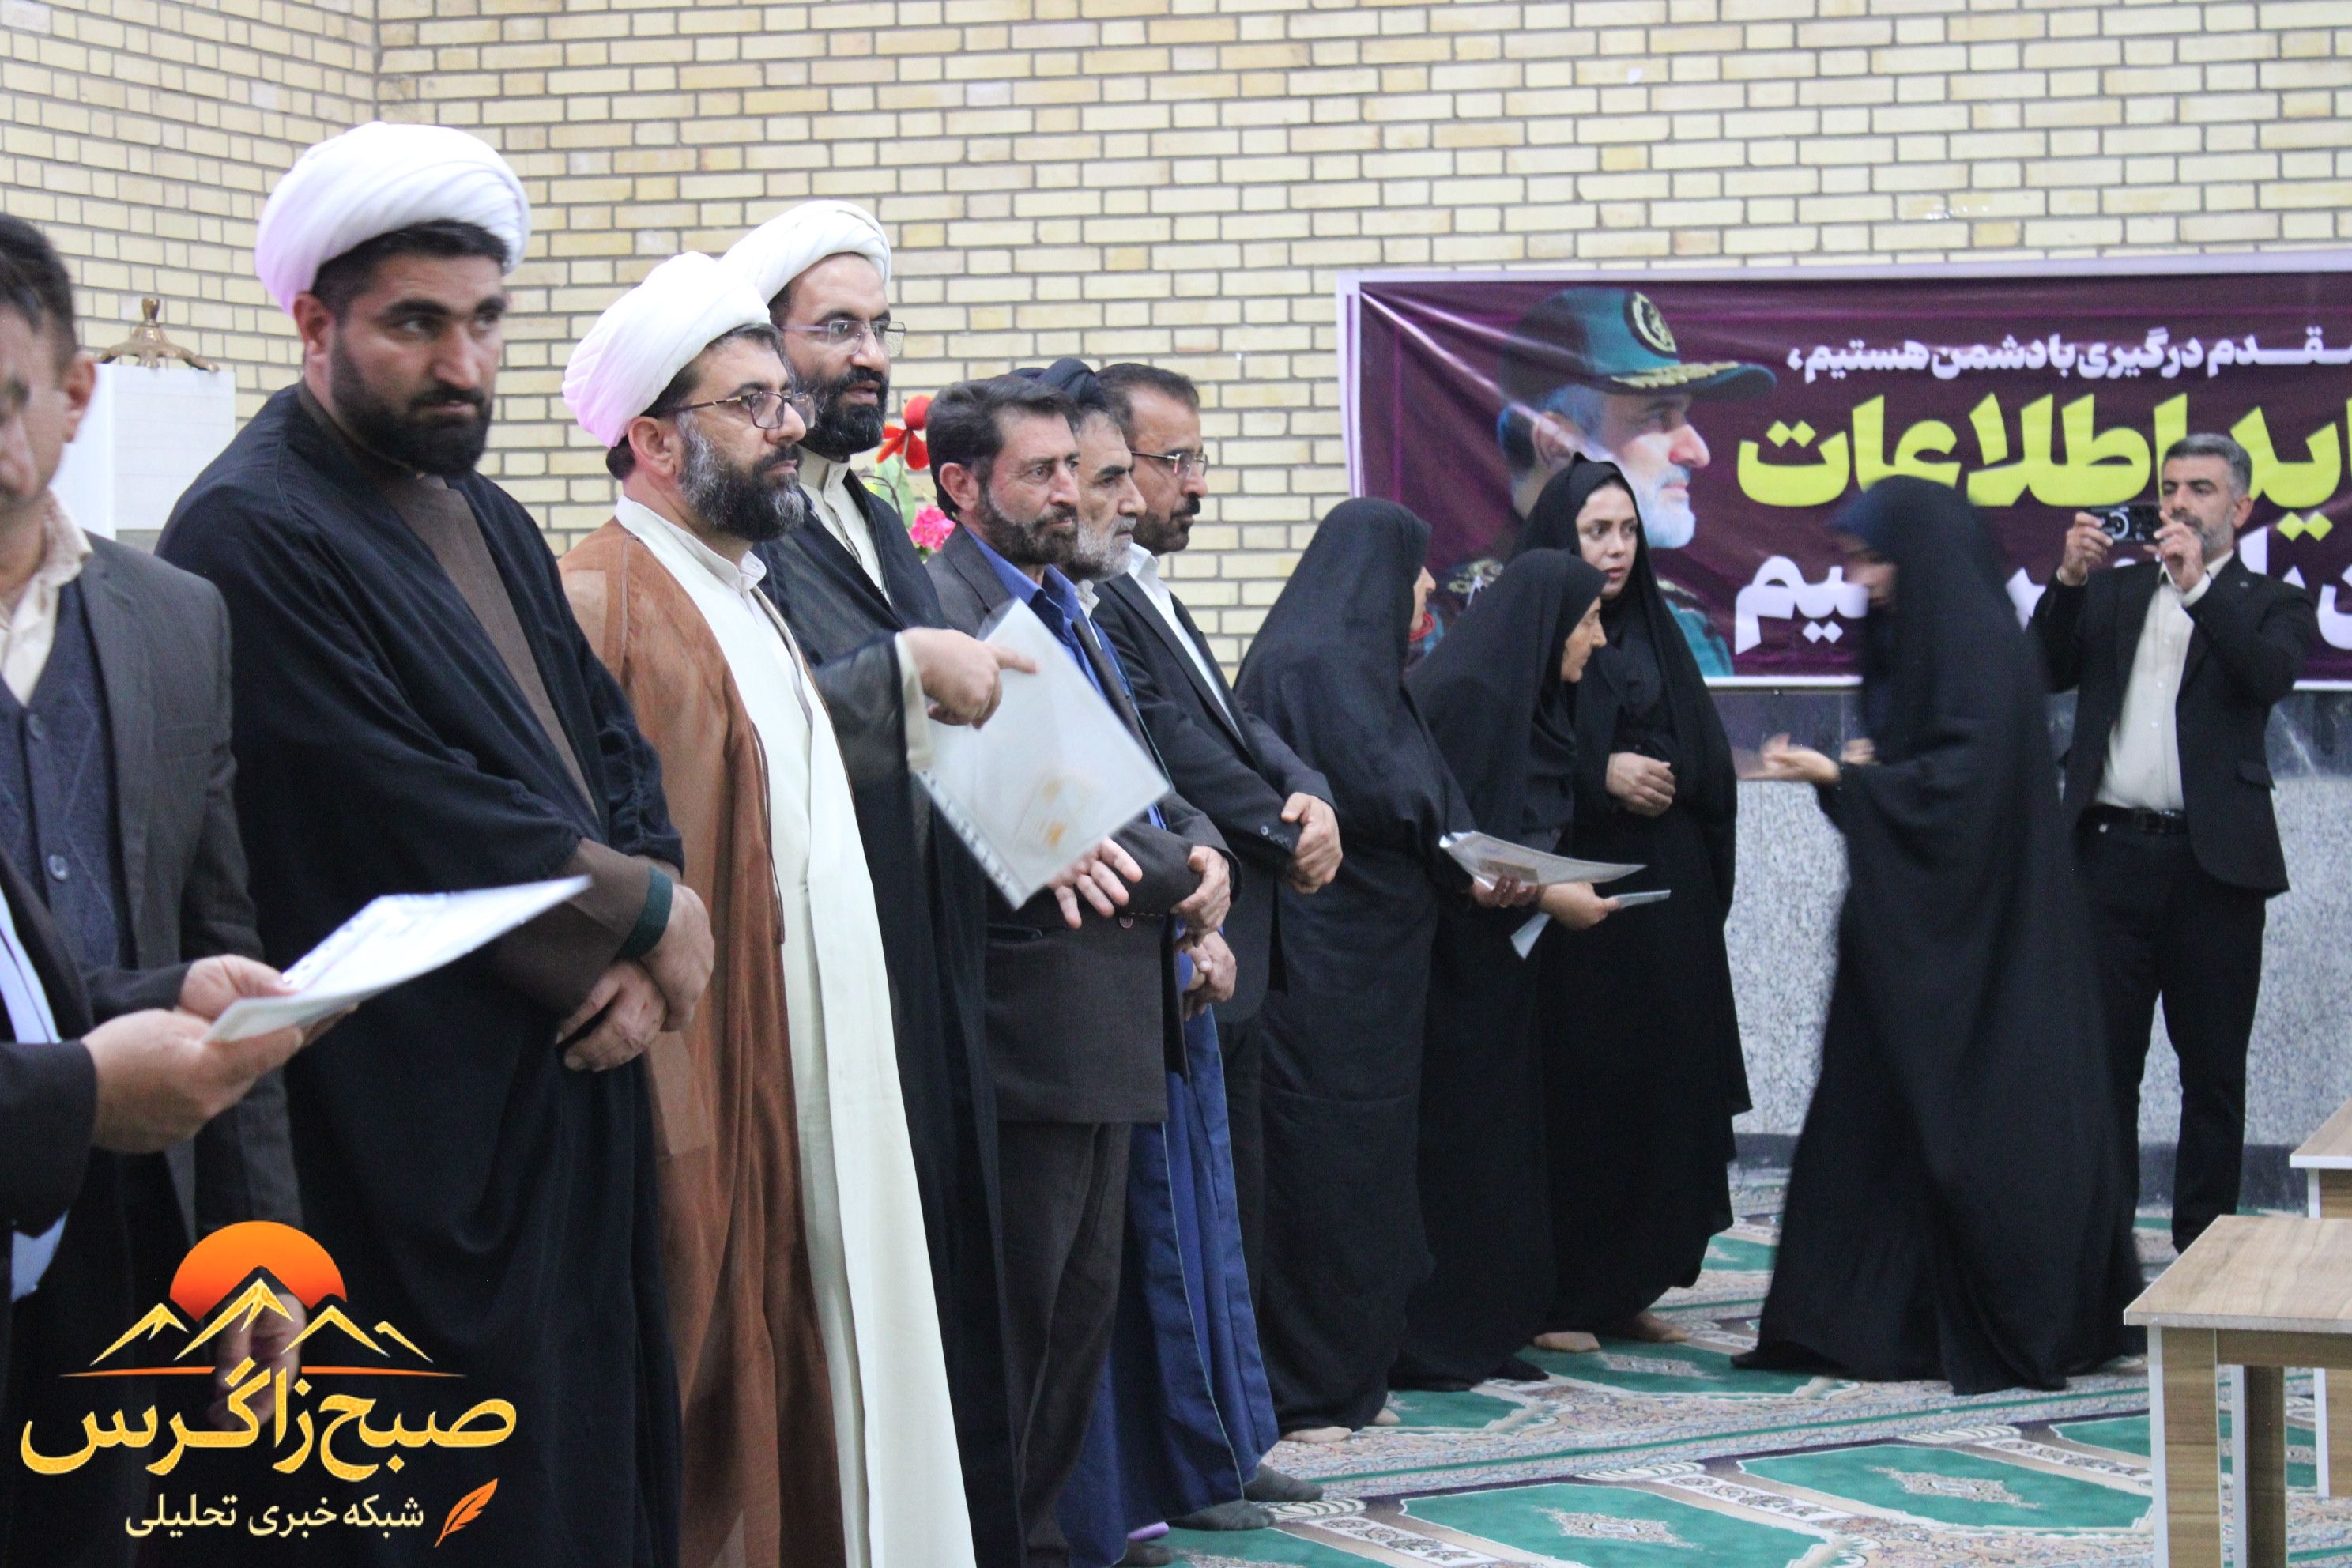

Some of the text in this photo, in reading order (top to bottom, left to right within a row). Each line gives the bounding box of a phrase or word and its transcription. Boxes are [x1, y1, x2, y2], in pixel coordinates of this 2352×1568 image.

[1787, 331, 1930, 384] هستیم،
[1931, 334, 2047, 380] دشمن
[2049, 332, 2076, 379] با
[1737, 391, 2188, 507] اطلاعات
